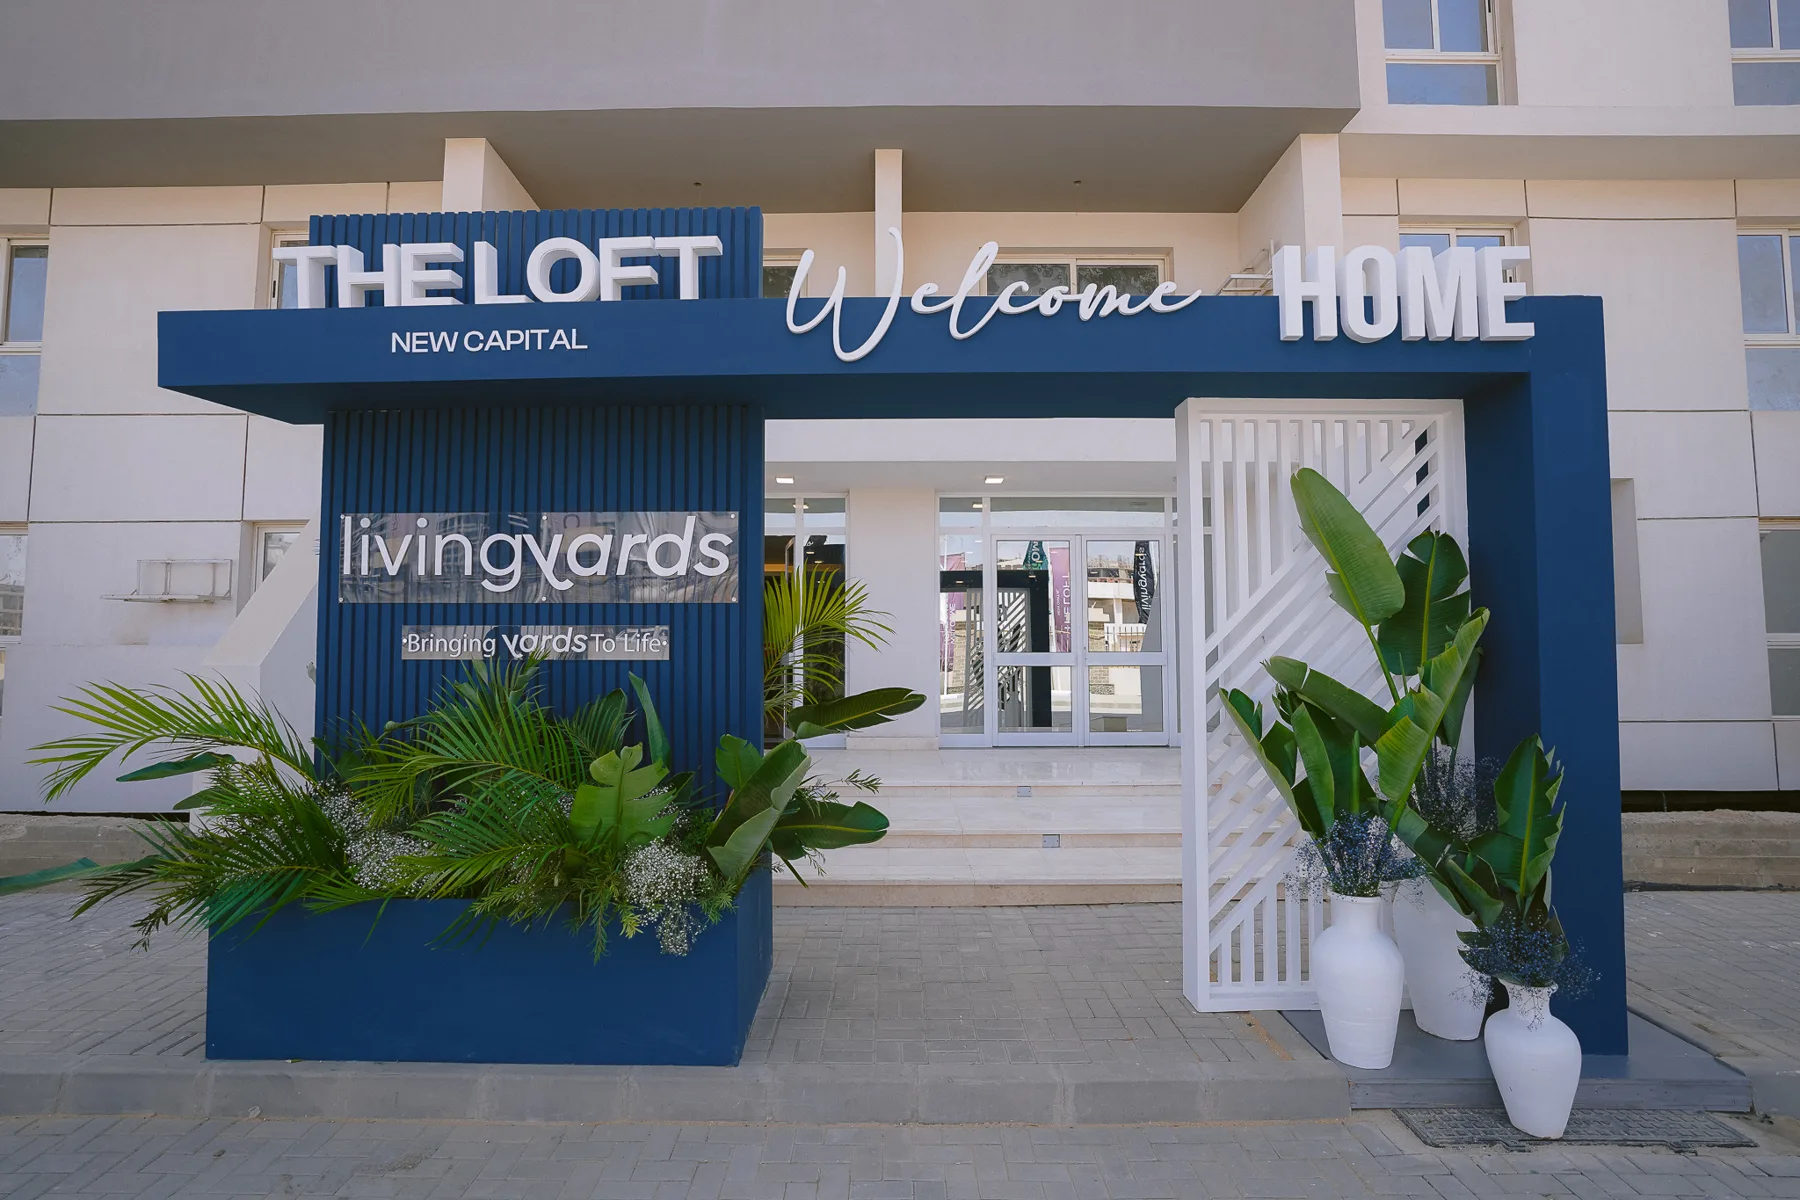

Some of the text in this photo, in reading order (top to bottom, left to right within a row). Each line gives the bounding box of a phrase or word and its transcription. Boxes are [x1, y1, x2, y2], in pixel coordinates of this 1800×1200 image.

[272, 235, 724, 309] THE LOFT
[785, 226, 1536, 362] Welcome HOME
[390, 328, 589, 354] NEW CAPITAL
[343, 515, 733, 593] livingyards
[407, 627, 662, 658] Bringing yards To Life
